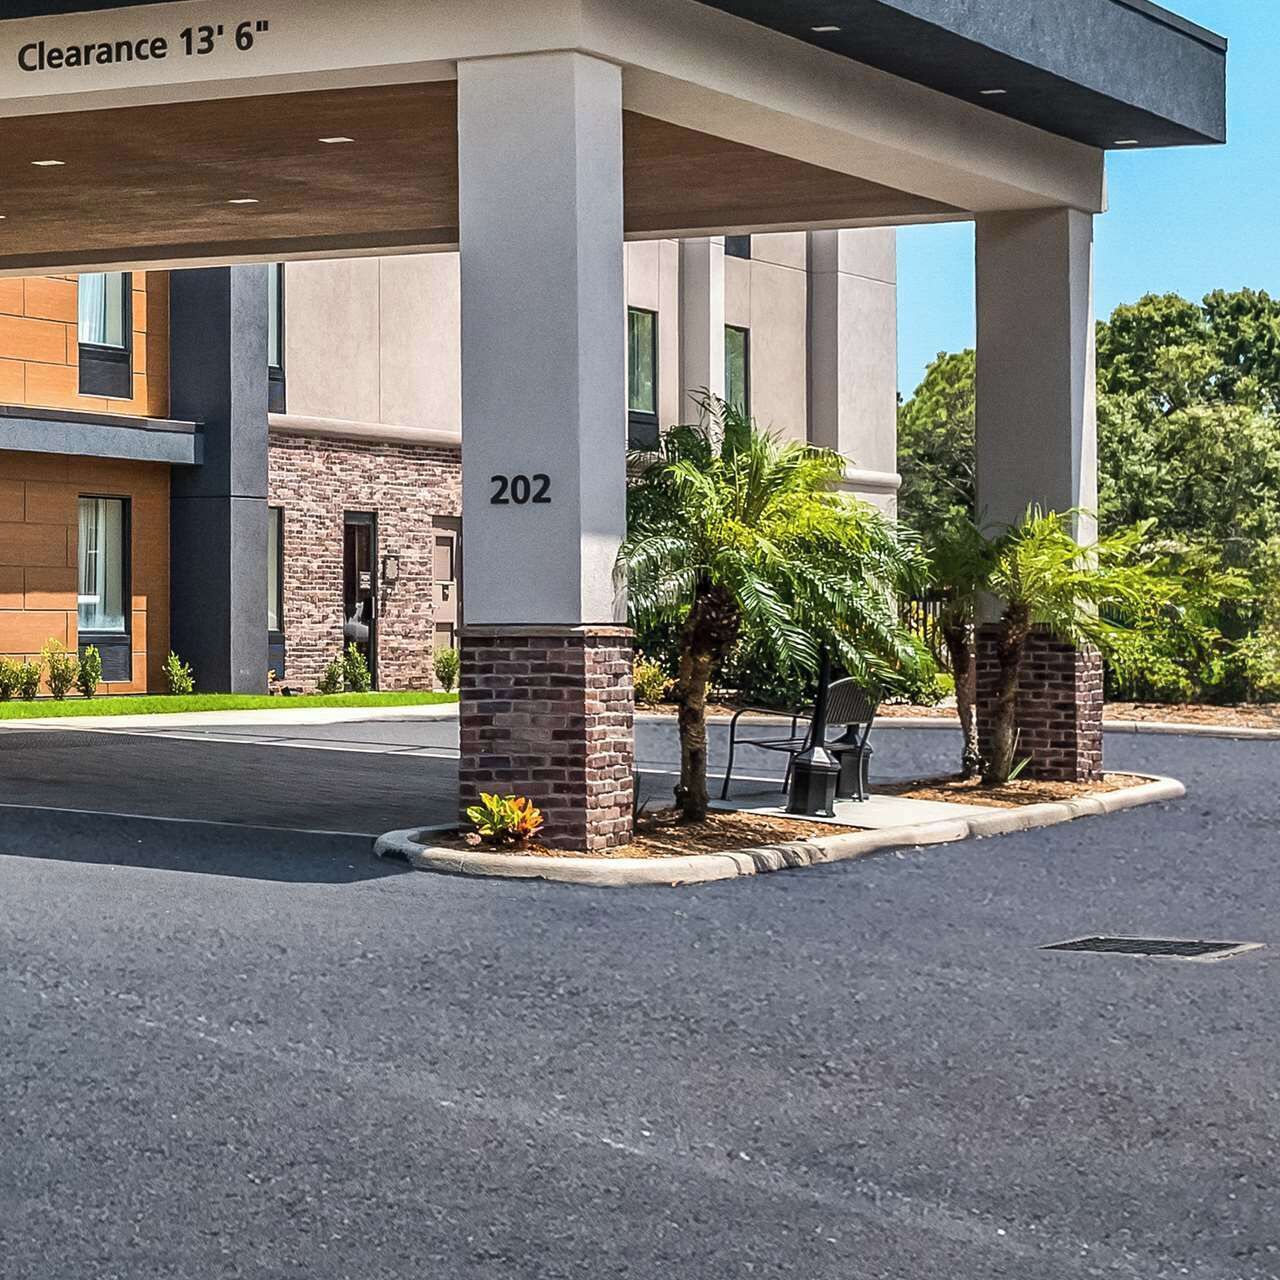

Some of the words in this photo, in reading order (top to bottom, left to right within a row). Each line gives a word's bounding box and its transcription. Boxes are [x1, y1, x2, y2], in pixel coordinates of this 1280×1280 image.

[18, 36, 167, 71] Clearance
[180, 24, 224, 56] 13'
[235, 20, 269, 51] 6"
[490, 473, 552, 504] 202
